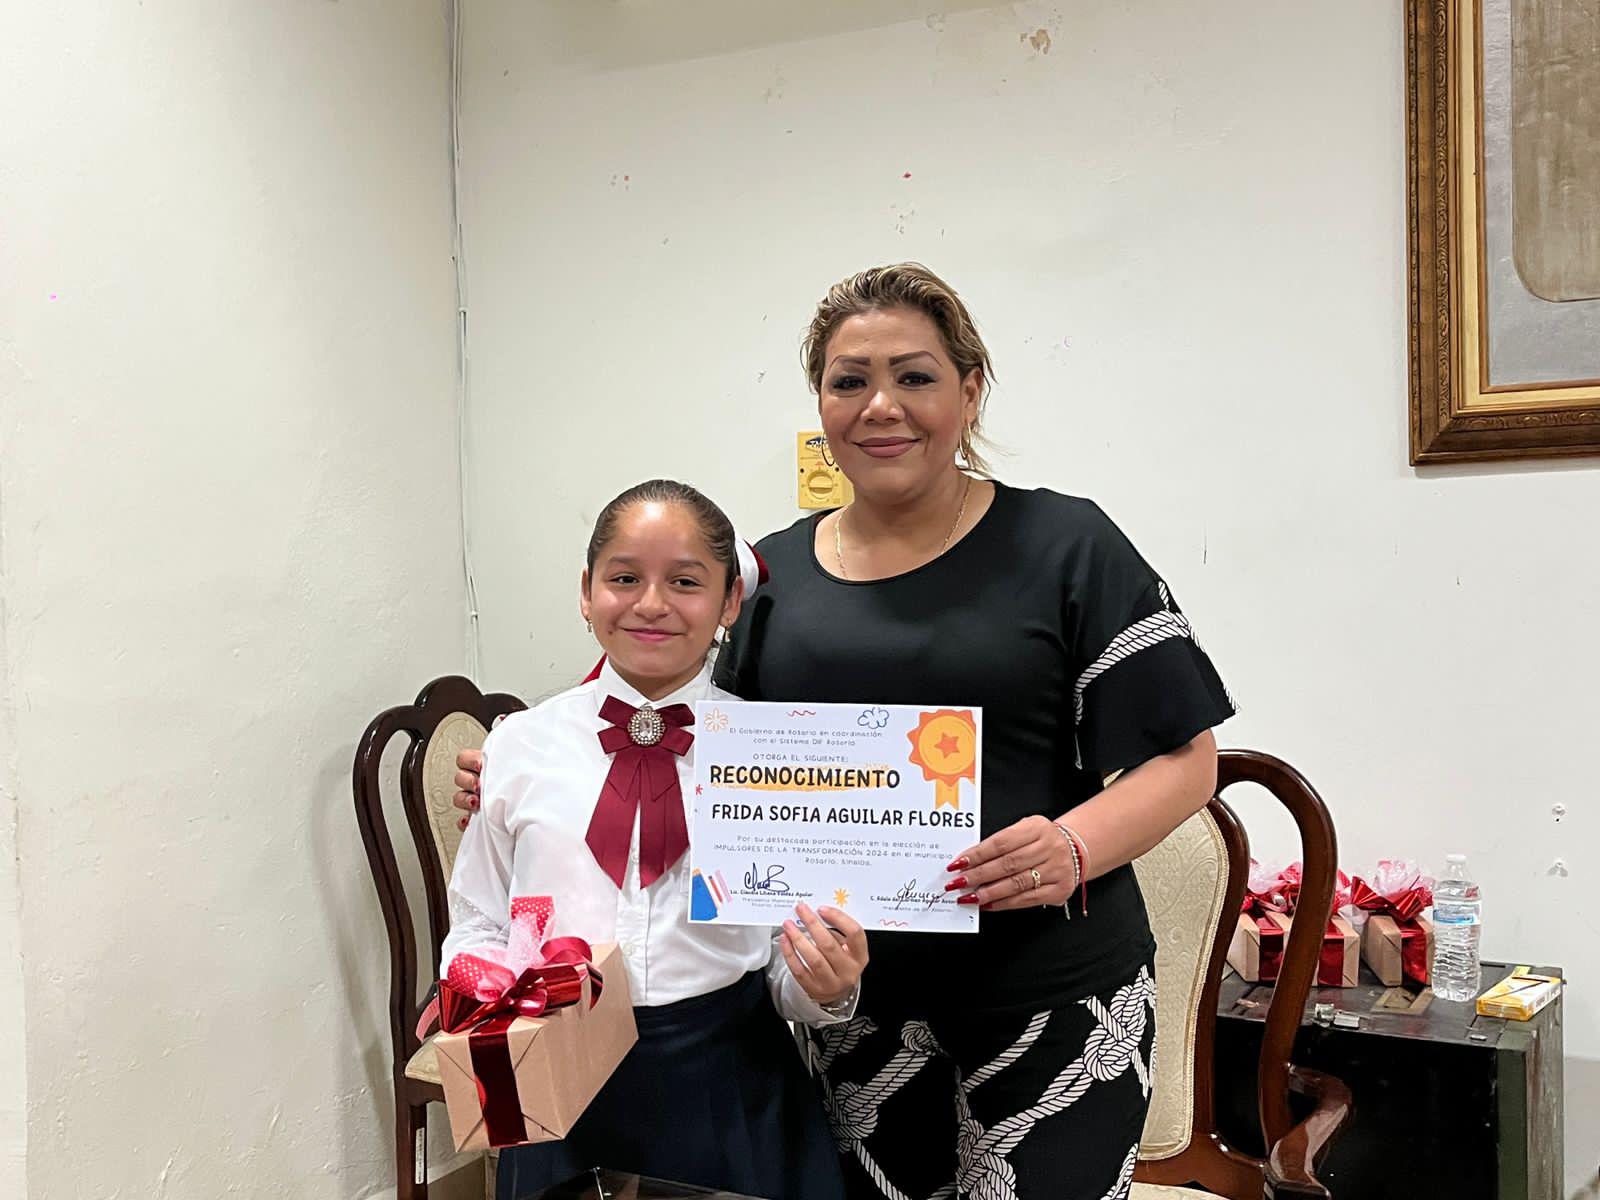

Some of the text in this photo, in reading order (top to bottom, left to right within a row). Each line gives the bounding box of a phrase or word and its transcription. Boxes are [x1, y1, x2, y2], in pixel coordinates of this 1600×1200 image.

[805, 754, 848, 763] SIGUIENTE:
[710, 766, 900, 788] RECONOCIMIENTO
[712, 804, 975, 828] FRIDA SOFIA AGUILAR FLORES
[812, 838, 865, 846] participación
[714, 844, 760, 852] IMPULSORES
[792, 847, 862, 856] TRANSFORMACIÓN
